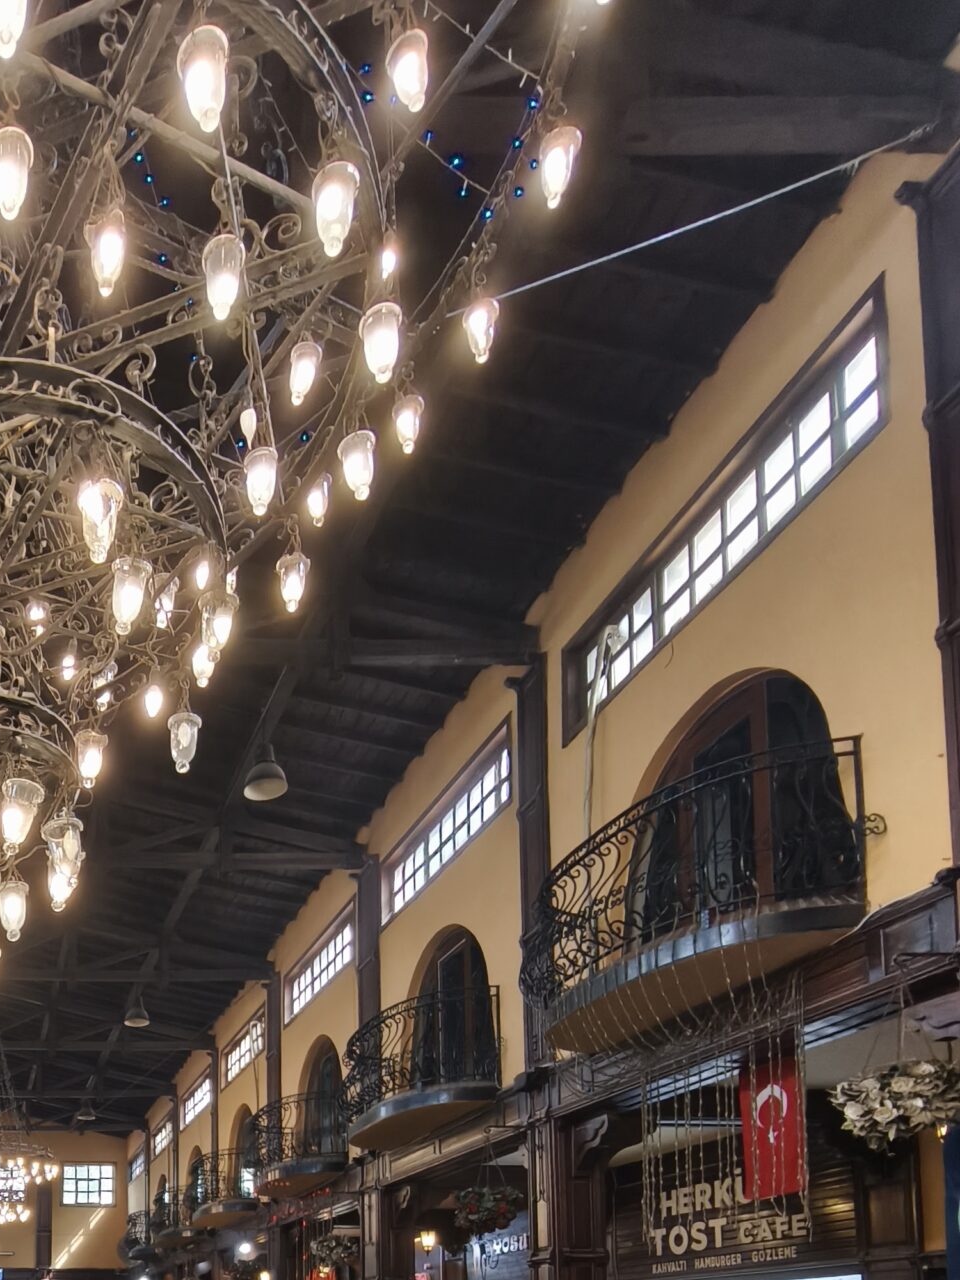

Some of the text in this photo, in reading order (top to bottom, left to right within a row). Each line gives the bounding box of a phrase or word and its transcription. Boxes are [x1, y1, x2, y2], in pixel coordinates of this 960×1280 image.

[652, 1213, 807, 1257] TOST CAFE
[652, 1260, 687, 1274] KAHVALTI
[694, 1253, 742, 1270] HAMBURGER
